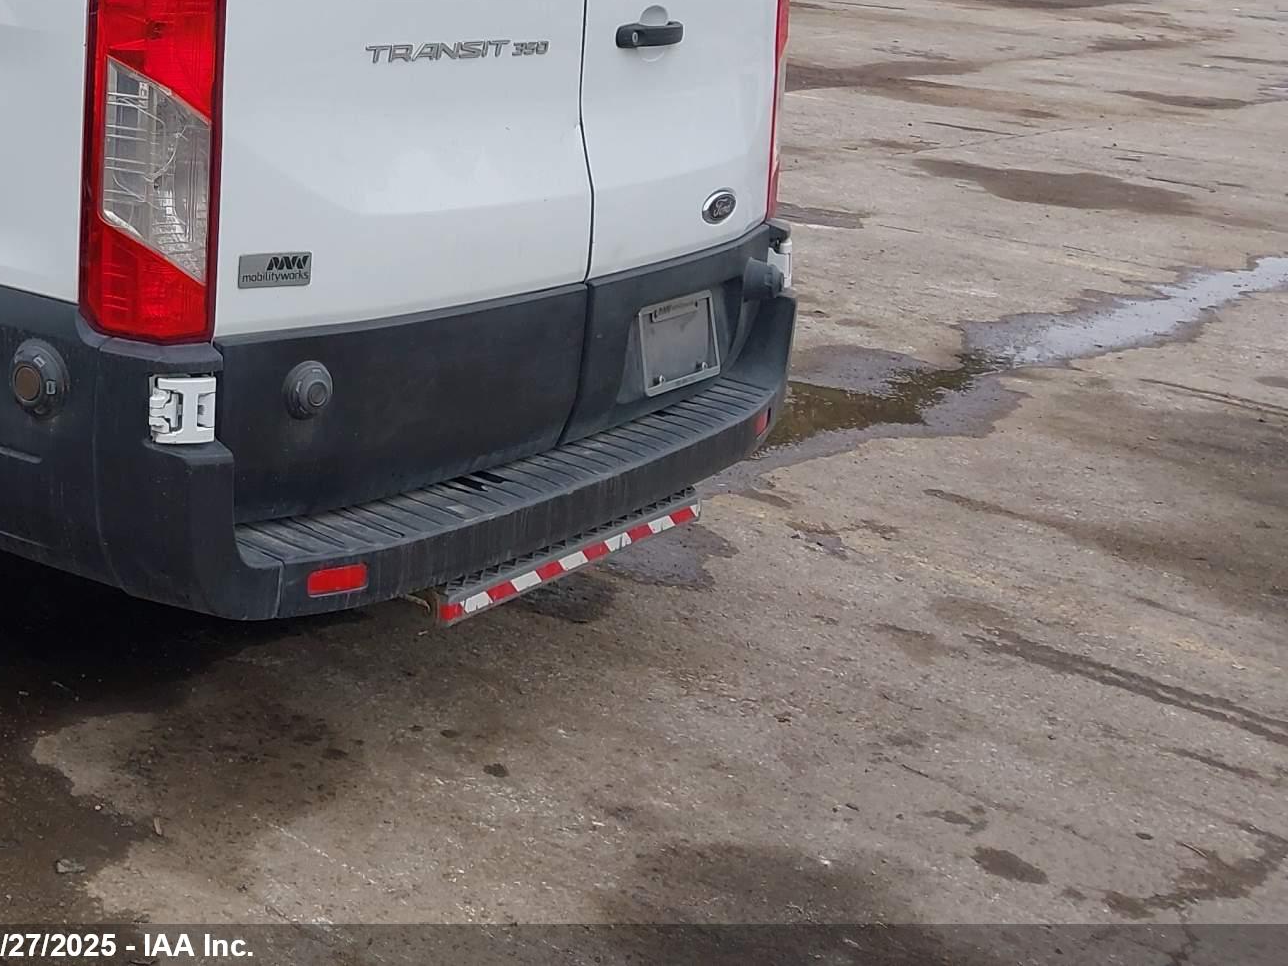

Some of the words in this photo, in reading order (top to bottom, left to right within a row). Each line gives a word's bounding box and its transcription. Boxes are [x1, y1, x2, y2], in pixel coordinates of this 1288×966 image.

[365, 40, 511, 63] TRANSIT
[512, 41, 550, 56] 350
[242, 270, 310, 283] mobilityworks
